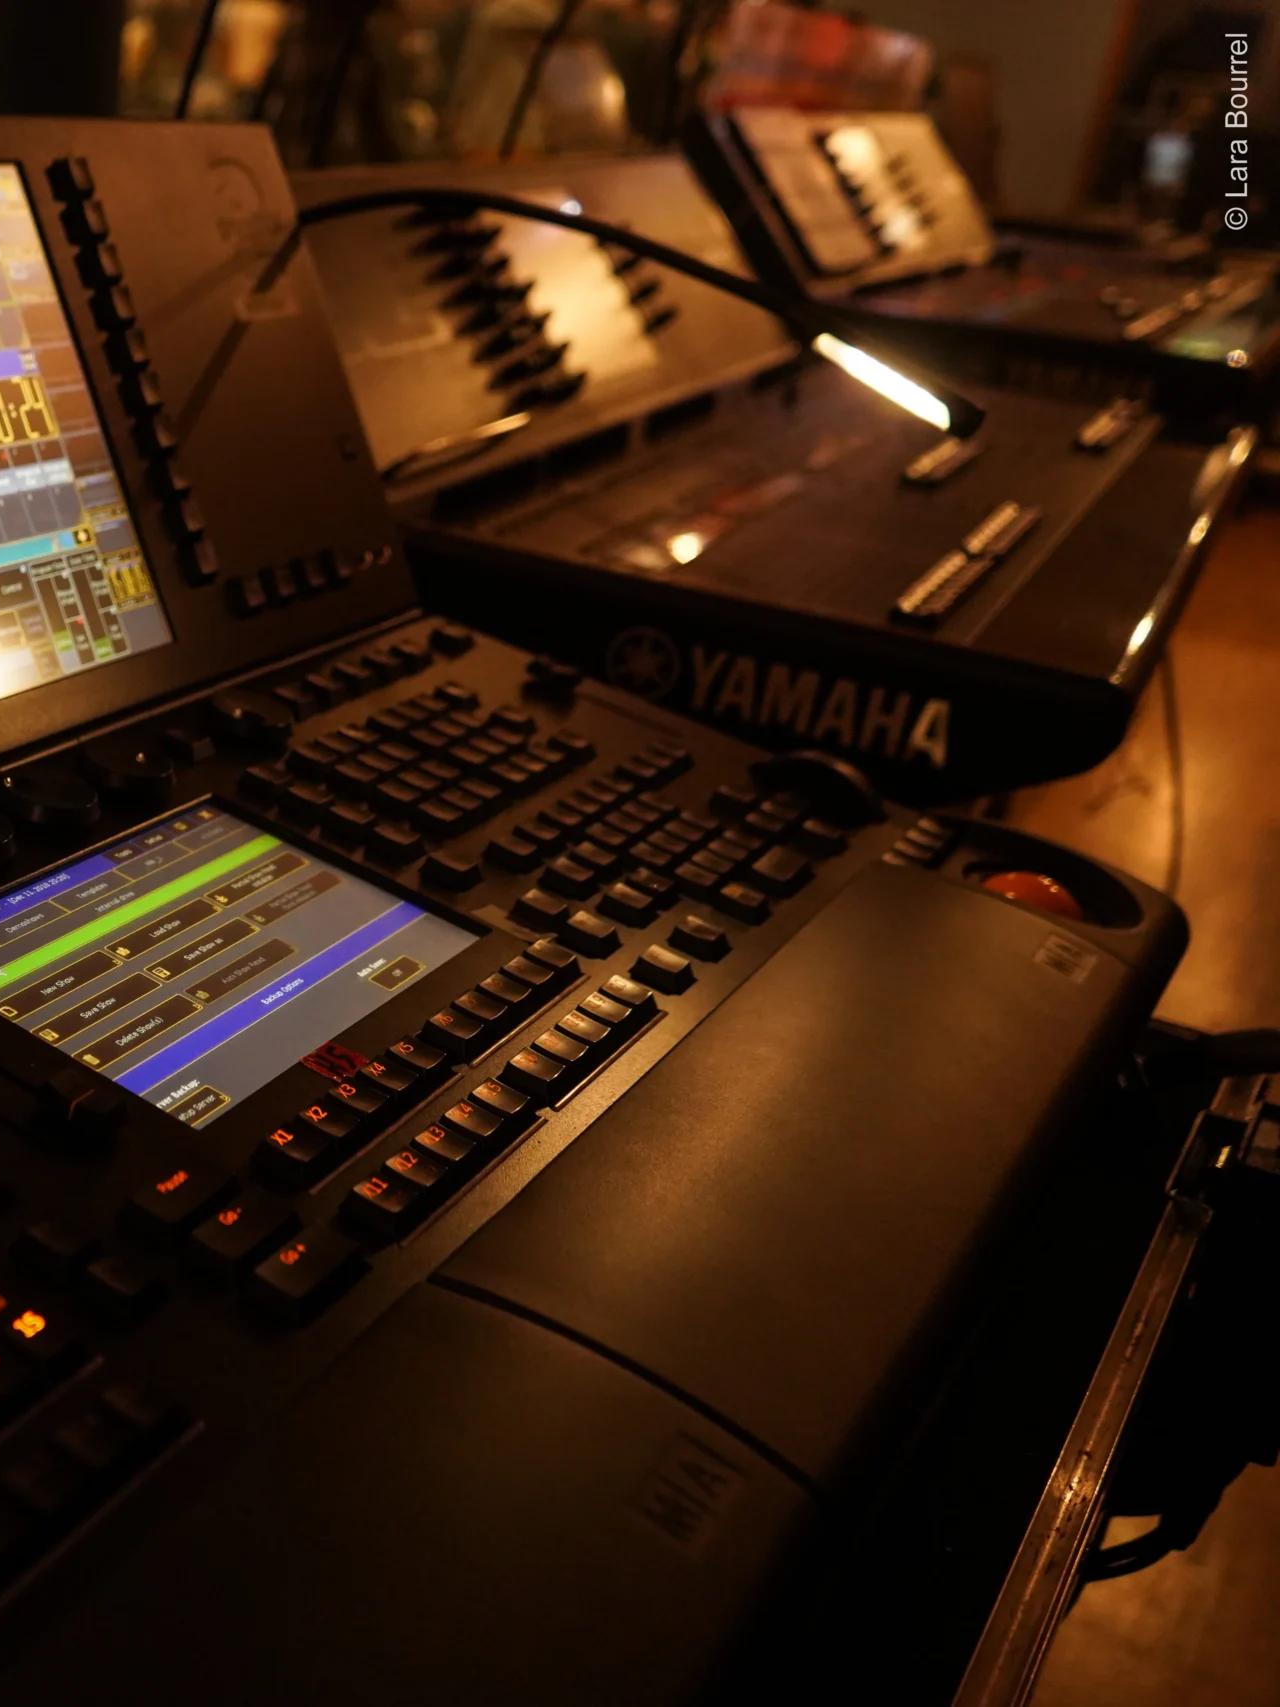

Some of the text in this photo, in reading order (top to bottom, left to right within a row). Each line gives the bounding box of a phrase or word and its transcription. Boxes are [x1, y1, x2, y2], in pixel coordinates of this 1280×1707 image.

[692, 645, 951, 770] YAMAHA
[76, 882, 108, 899] Templates
[5, 913, 45, 934] Demoshows
[184, 948, 201, 961] Save
[198, 940, 216, 954] Show
[40, 975, 75, 996] New Show
[260, 977, 304, 1005] Backup Options
[80, 996, 117, 1019] Save Show
[115, 1016, 164, 1046] Delete Show(s)
[398, 1042, 414, 1056] X5
[369, 1061, 387, 1077] X4
[337, 1083, 356, 1098] X3
[306, 1105, 328, 1122] X2
[270, 1129, 293, 1146] X1
[423, 1125, 446, 1146] X13
[395, 1151, 418, 1172] X12
[362, 1176, 389, 1199] X11
[12, 1310, 46, 1339] 15
